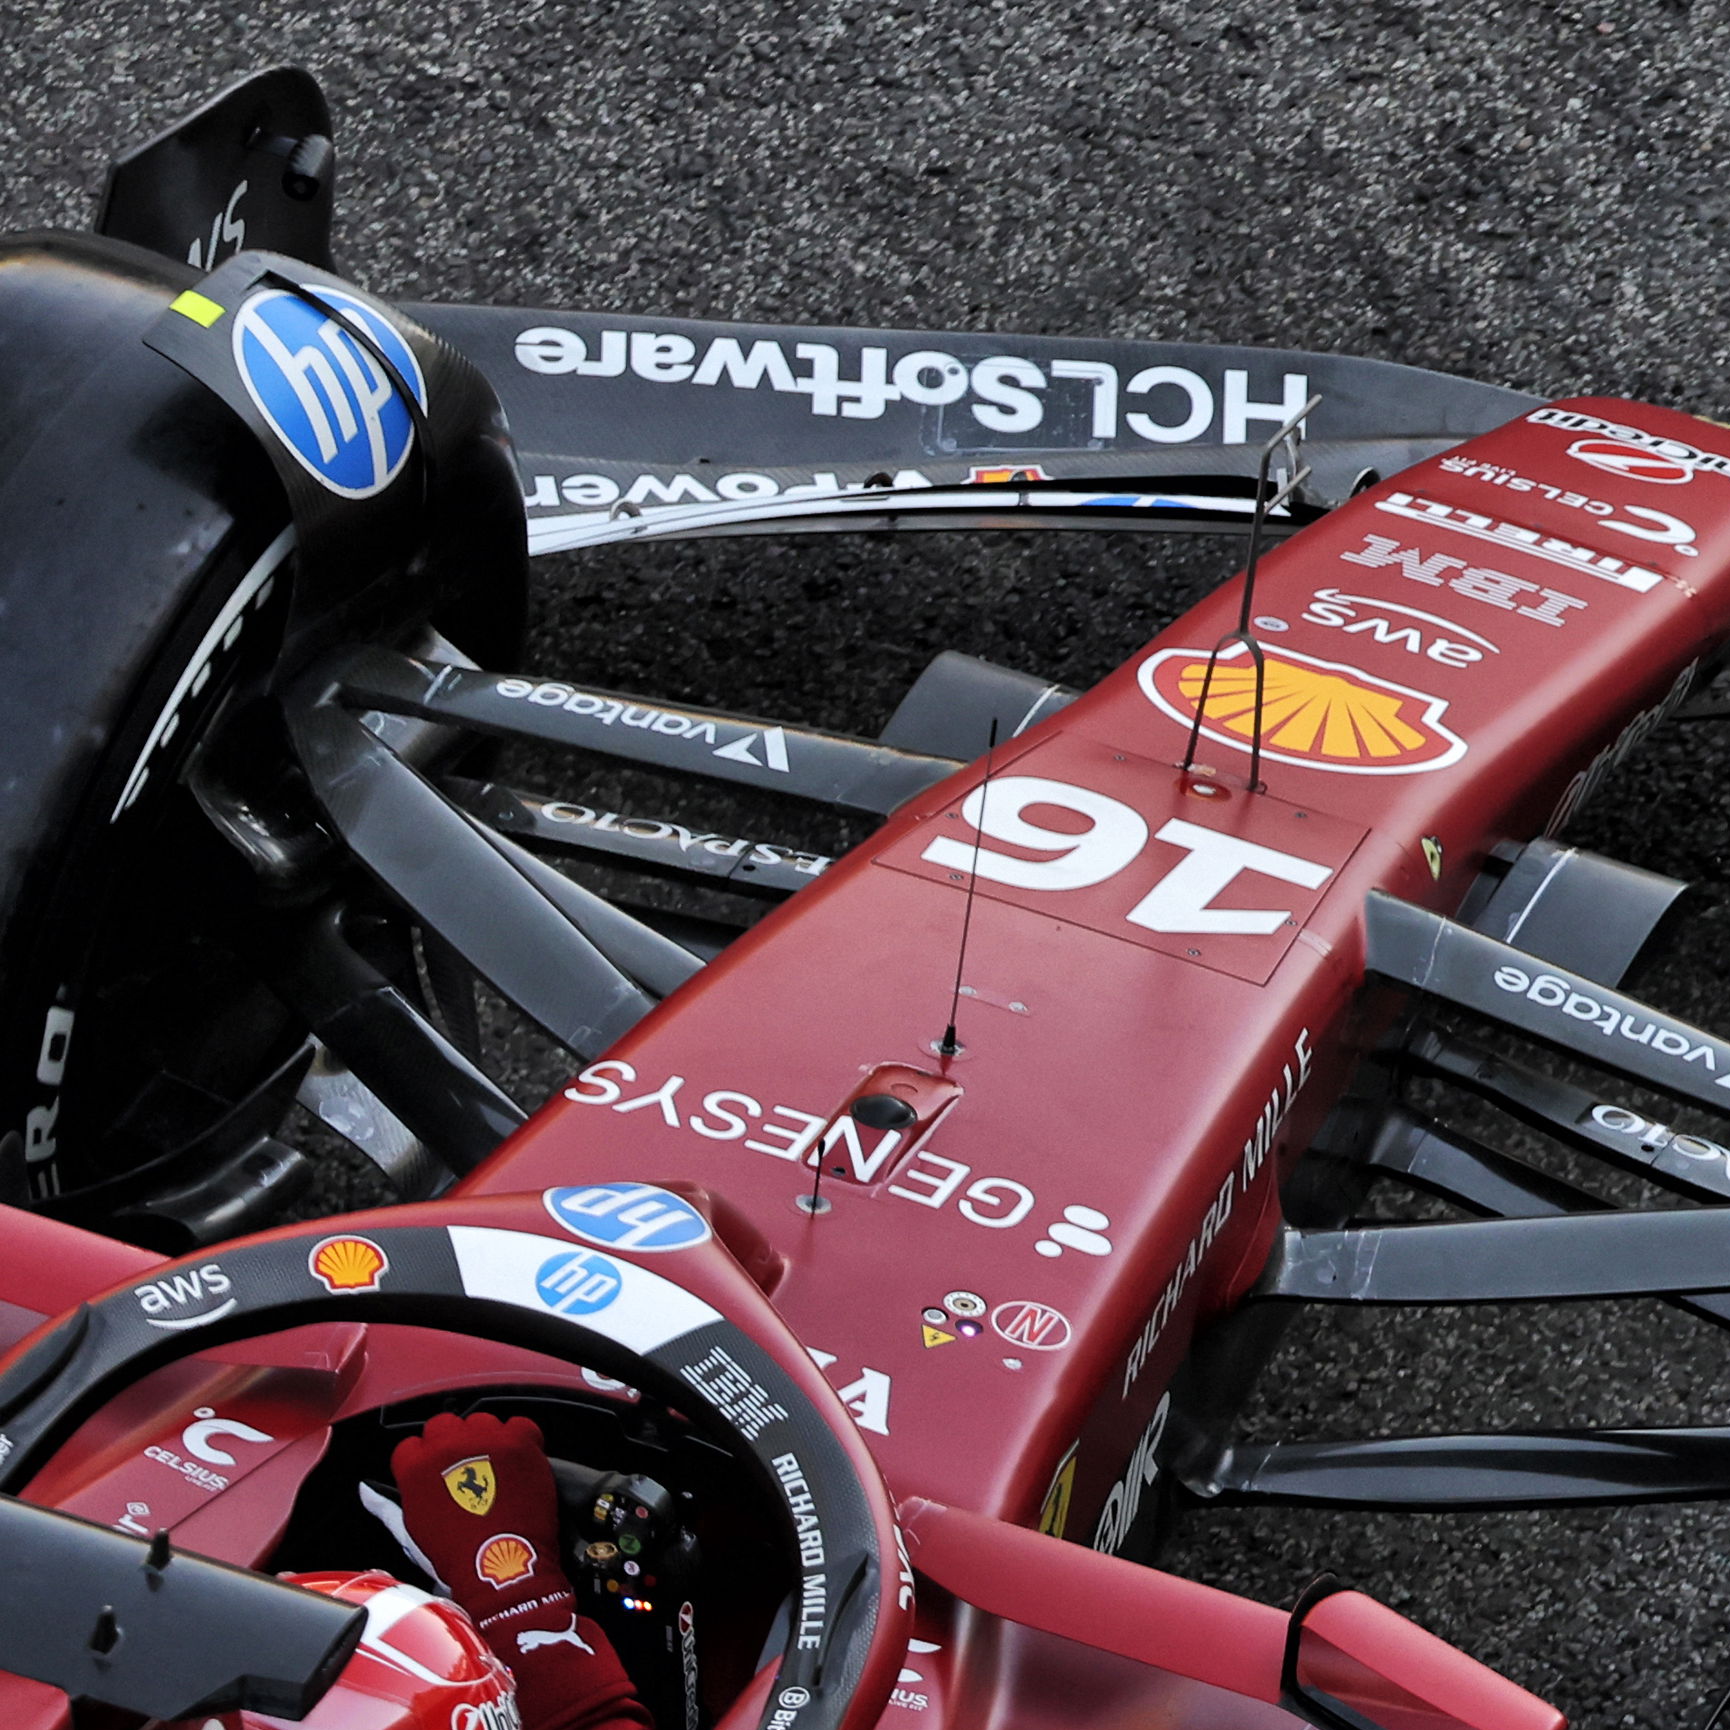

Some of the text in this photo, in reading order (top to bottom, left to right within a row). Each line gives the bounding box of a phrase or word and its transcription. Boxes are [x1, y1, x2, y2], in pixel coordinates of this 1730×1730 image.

[240, 300, 412, 492] hp
[513, 326, 1309, 446] HCLSoftware
[1438, 459, 1615, 516] CELSIUS
[1340, 533, 1590, 629] IBM
[1374, 492, 1665, 595] PIRELLI
[1301, 602, 1485, 669] aws
[920, 775, 1334, 935] 16
[563, 1058, 1035, 1229] GENESYS
[556, 1182, 700, 1251] hp
[1122, 1171, 1236, 1401] RICHARD
[1242, 1040, 1313, 1194] MILLE
[133, 1263, 233, 1314] aws
[538, 1252, 622, 1313] hp
[680, 1345, 790, 1442] IBM
[143, 1445, 229, 1491] CELSIUS
[771, 1452, 828, 1651] RICHARD MILLE
